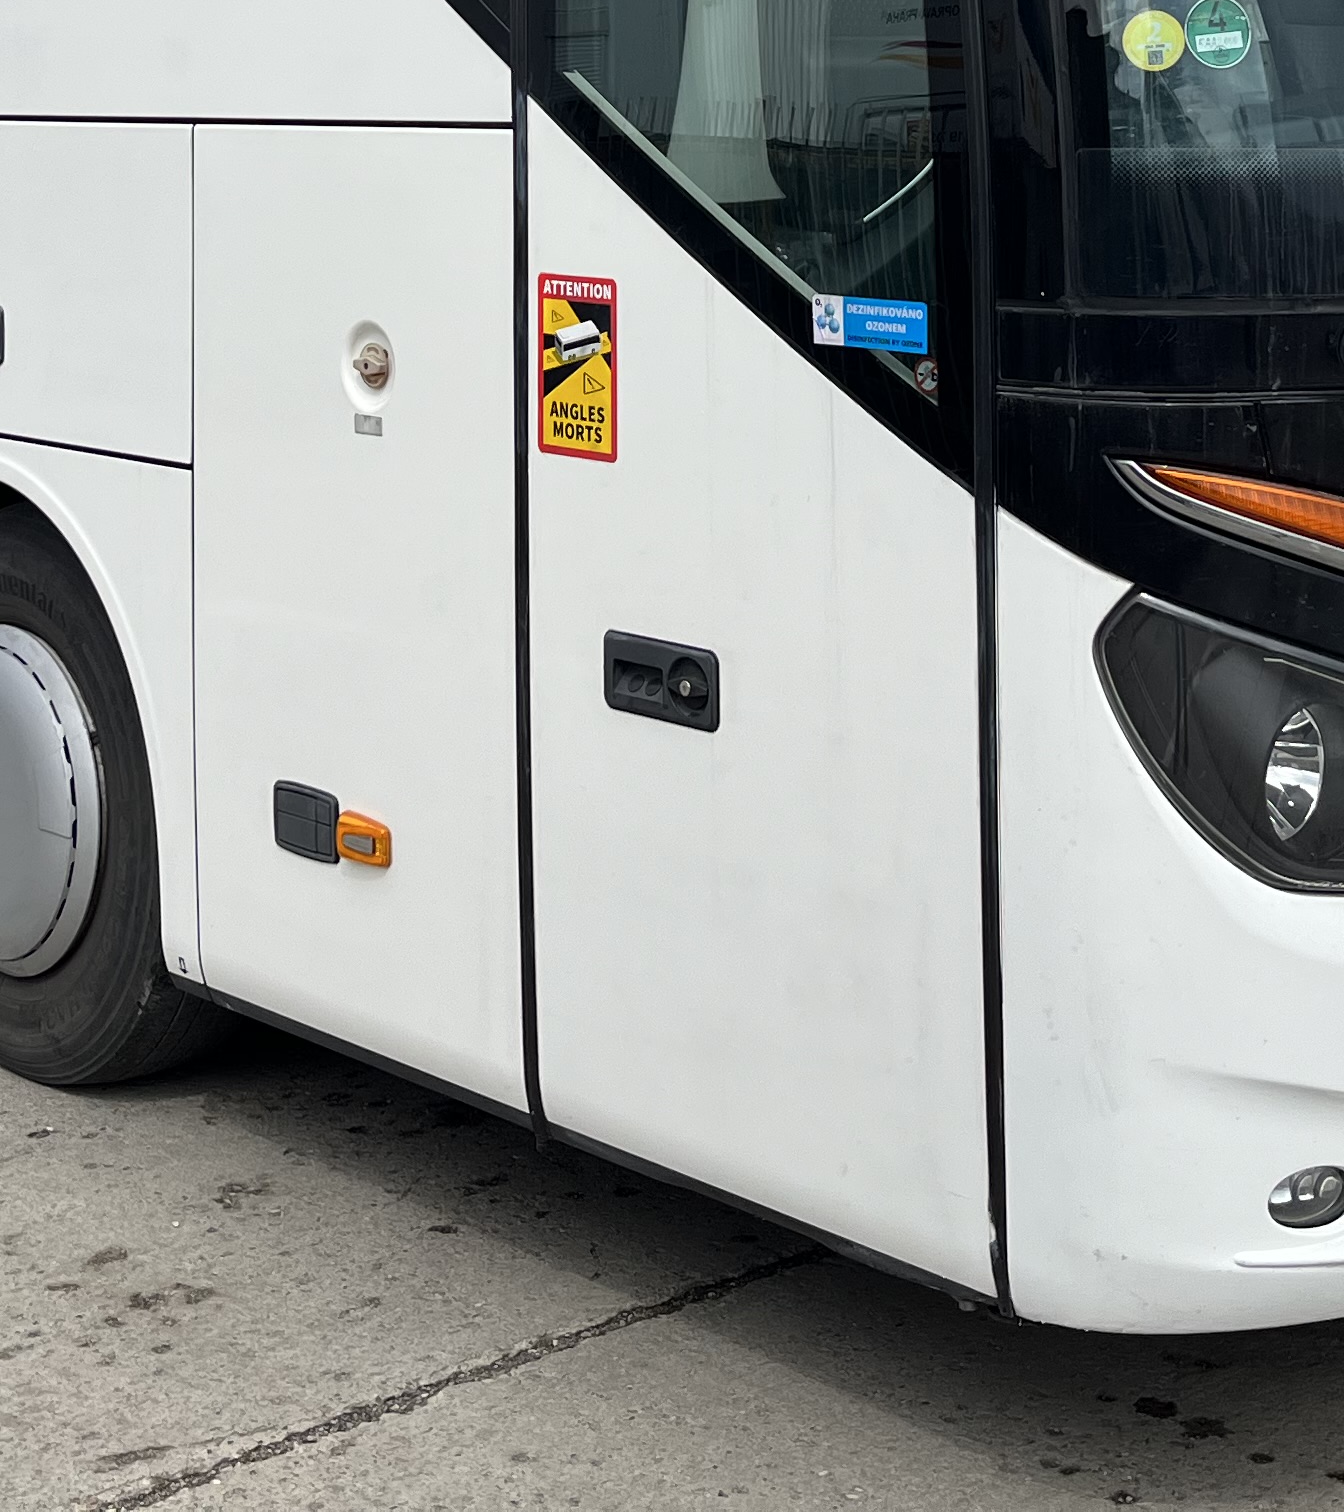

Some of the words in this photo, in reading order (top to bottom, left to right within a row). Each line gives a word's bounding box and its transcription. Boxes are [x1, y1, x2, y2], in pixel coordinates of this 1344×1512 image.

[1208, 0, 1227, 32] 4
[1147, 21, 1162, 43] 2
[543, 279, 612, 300] ATTENTION
[846, 303, 924, 320] DEZINFIKOVÁNO
[865, 320, 907, 334] OZONEM
[550, 400, 605, 424] ANGLES
[553, 420, 603, 444] MORTS
